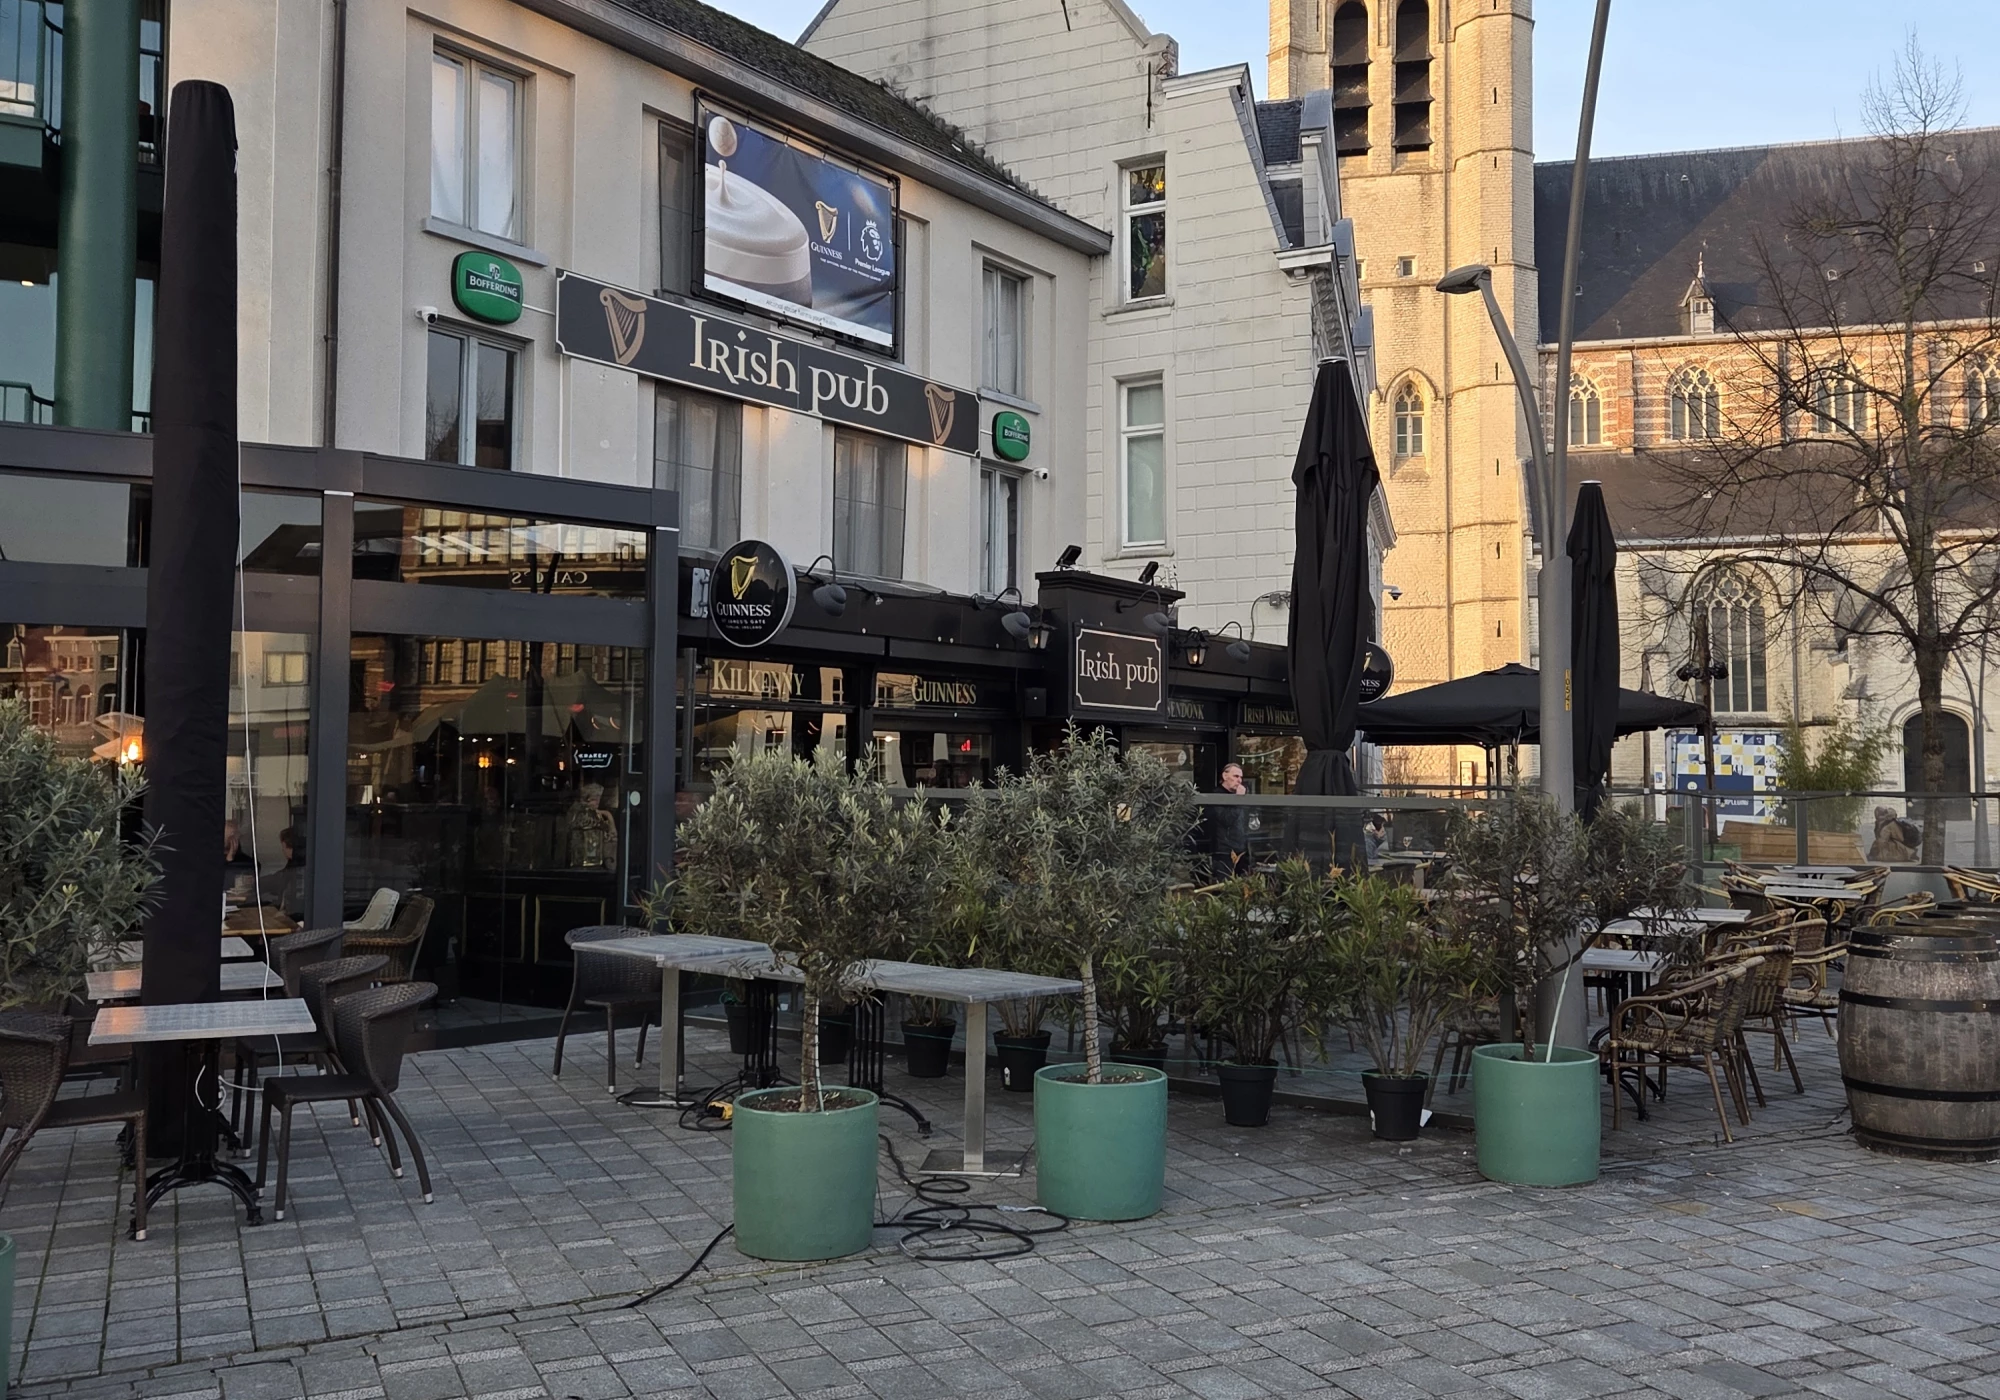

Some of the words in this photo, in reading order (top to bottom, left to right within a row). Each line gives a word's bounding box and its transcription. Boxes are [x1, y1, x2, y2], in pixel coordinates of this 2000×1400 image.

[810, 241, 843, 260] GUINNESS
[469, 275, 518, 297] BOFFERDING
[689, 315, 800, 395] Irish
[807, 364, 889, 416] pub
[1004, 428, 1029, 442] BOFFERDING
[716, 601, 772, 617] GUINNESS
[711, 659, 804, 696] KILKENNY
[1079, 649, 1121, 681] Irish
[1125, 657, 1158, 690] pub
[911, 674, 977, 705] GUINNESS
[1243, 703, 1265, 724] IRISH
[1265, 705, 1297, 726] WHISKE
